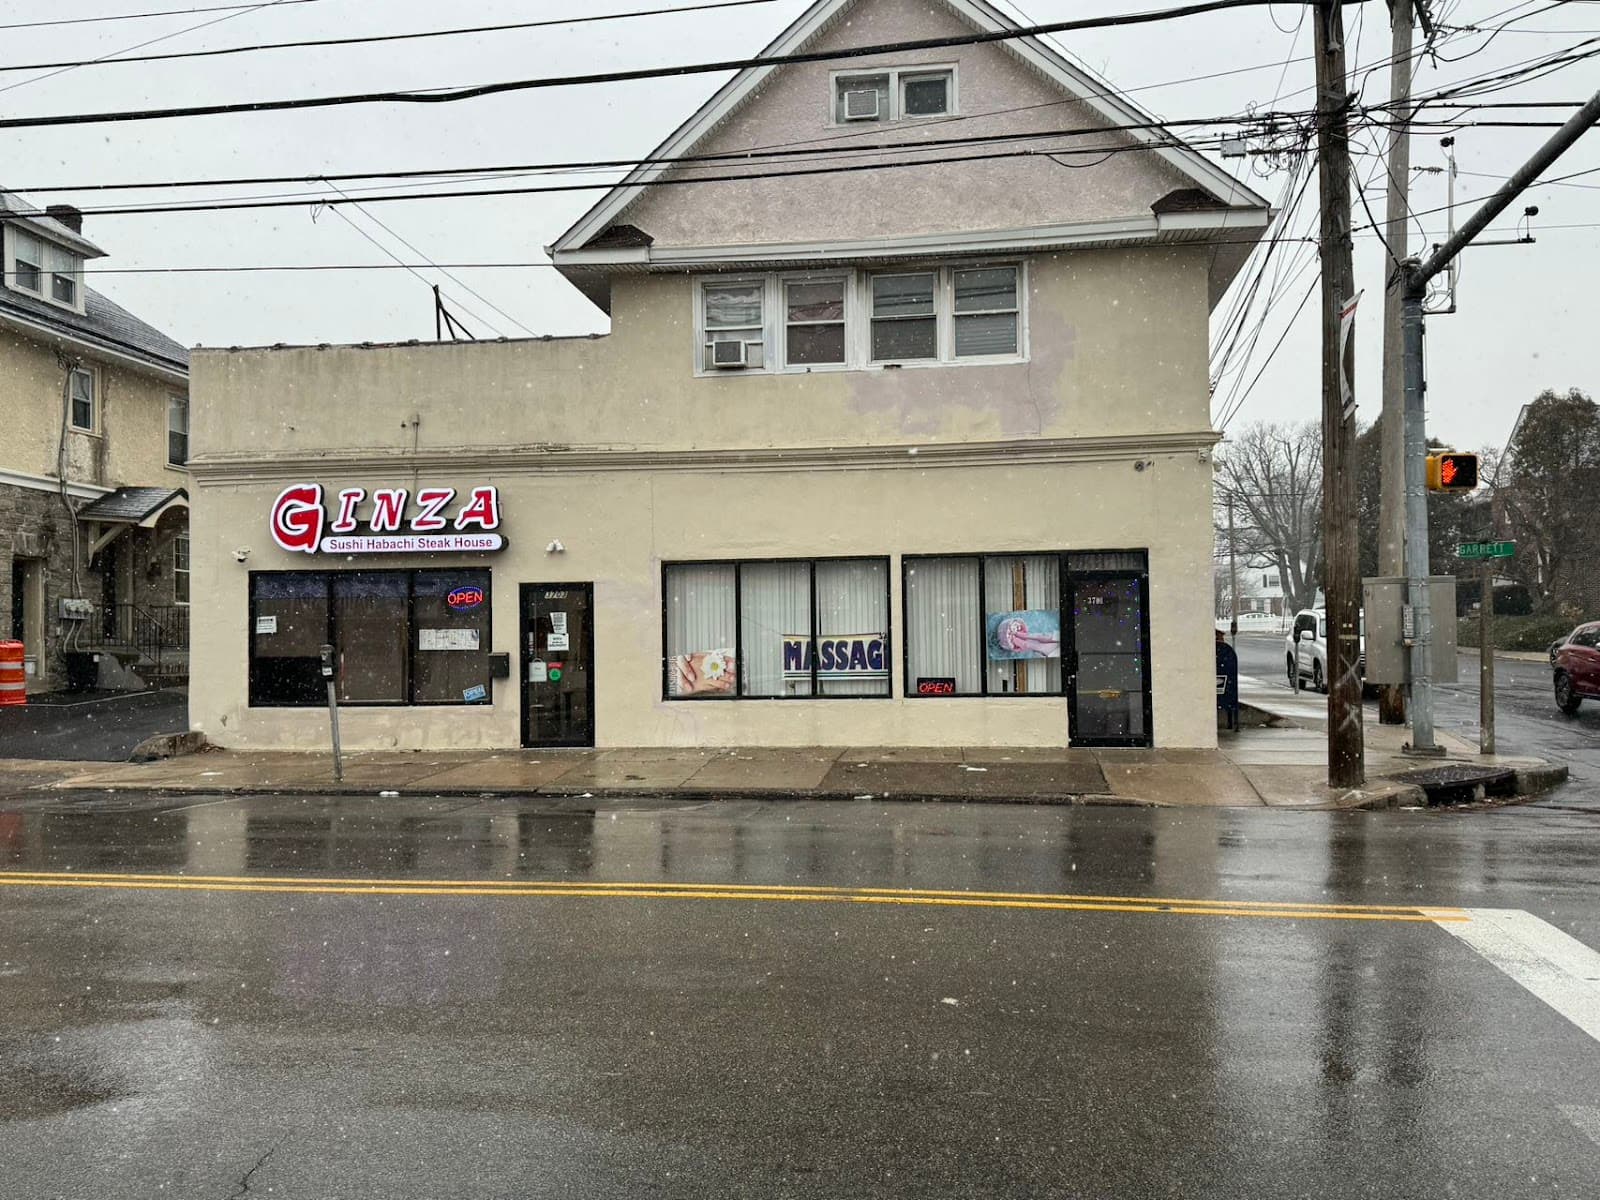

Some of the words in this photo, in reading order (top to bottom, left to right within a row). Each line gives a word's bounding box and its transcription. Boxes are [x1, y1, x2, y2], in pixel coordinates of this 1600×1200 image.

[270, 484, 499, 552] GINZA
[330, 539, 363, 550] Sushi
[367, 538, 414, 549] Habachi
[418, 537, 450, 548] Steak
[454, 537, 492, 547] House
[1459, 543, 1505, 555] GARRETT
[447, 591, 483, 605] OPEN
[783, 639, 889, 670] MASSAG
[918, 682, 953, 693] OPEN
